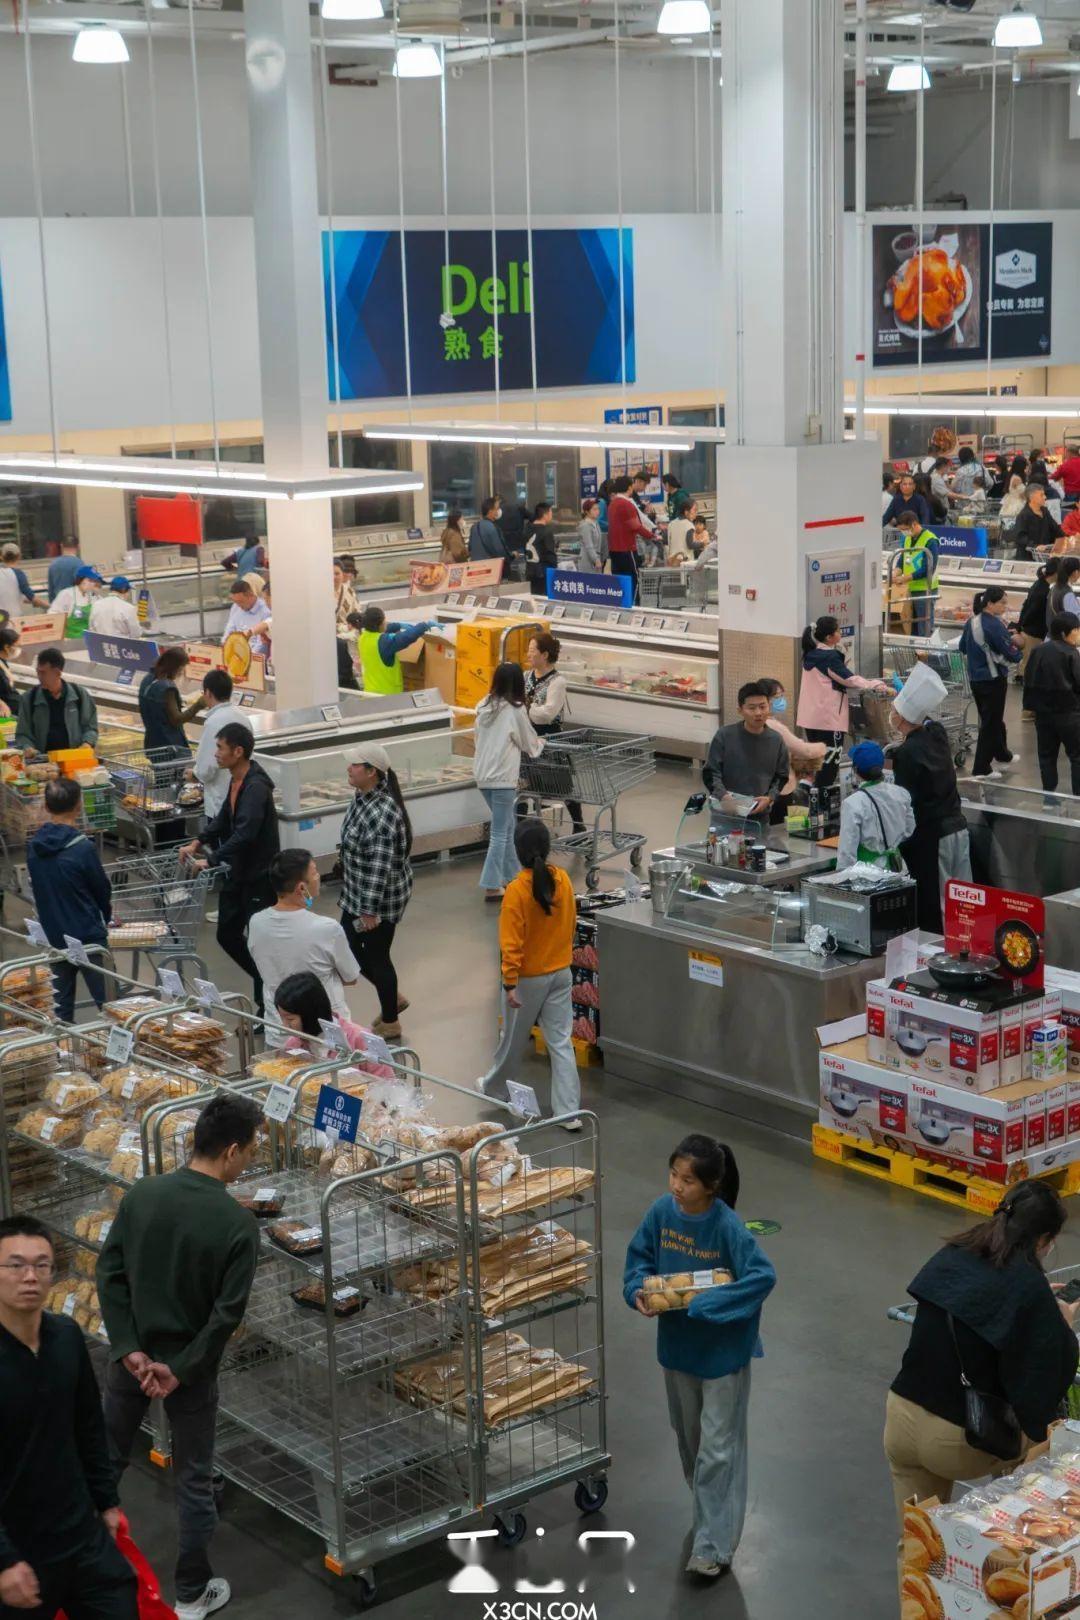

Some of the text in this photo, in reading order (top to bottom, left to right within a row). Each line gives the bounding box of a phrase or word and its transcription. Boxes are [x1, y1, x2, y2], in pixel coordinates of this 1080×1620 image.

[441, 261, 534, 316] Deli
[443, 326, 504, 361] 熟食
[939, 536, 967, 548] Chicken
[553, 580, 623, 597] 冷冻肉类 Frozen Meat
[951, 886, 983, 903] Tefal
[889, 995, 915, 1009] Tefal
[823, 1057, 847, 1071] Tefal
[911, 1083, 938, 1098] Tefal
